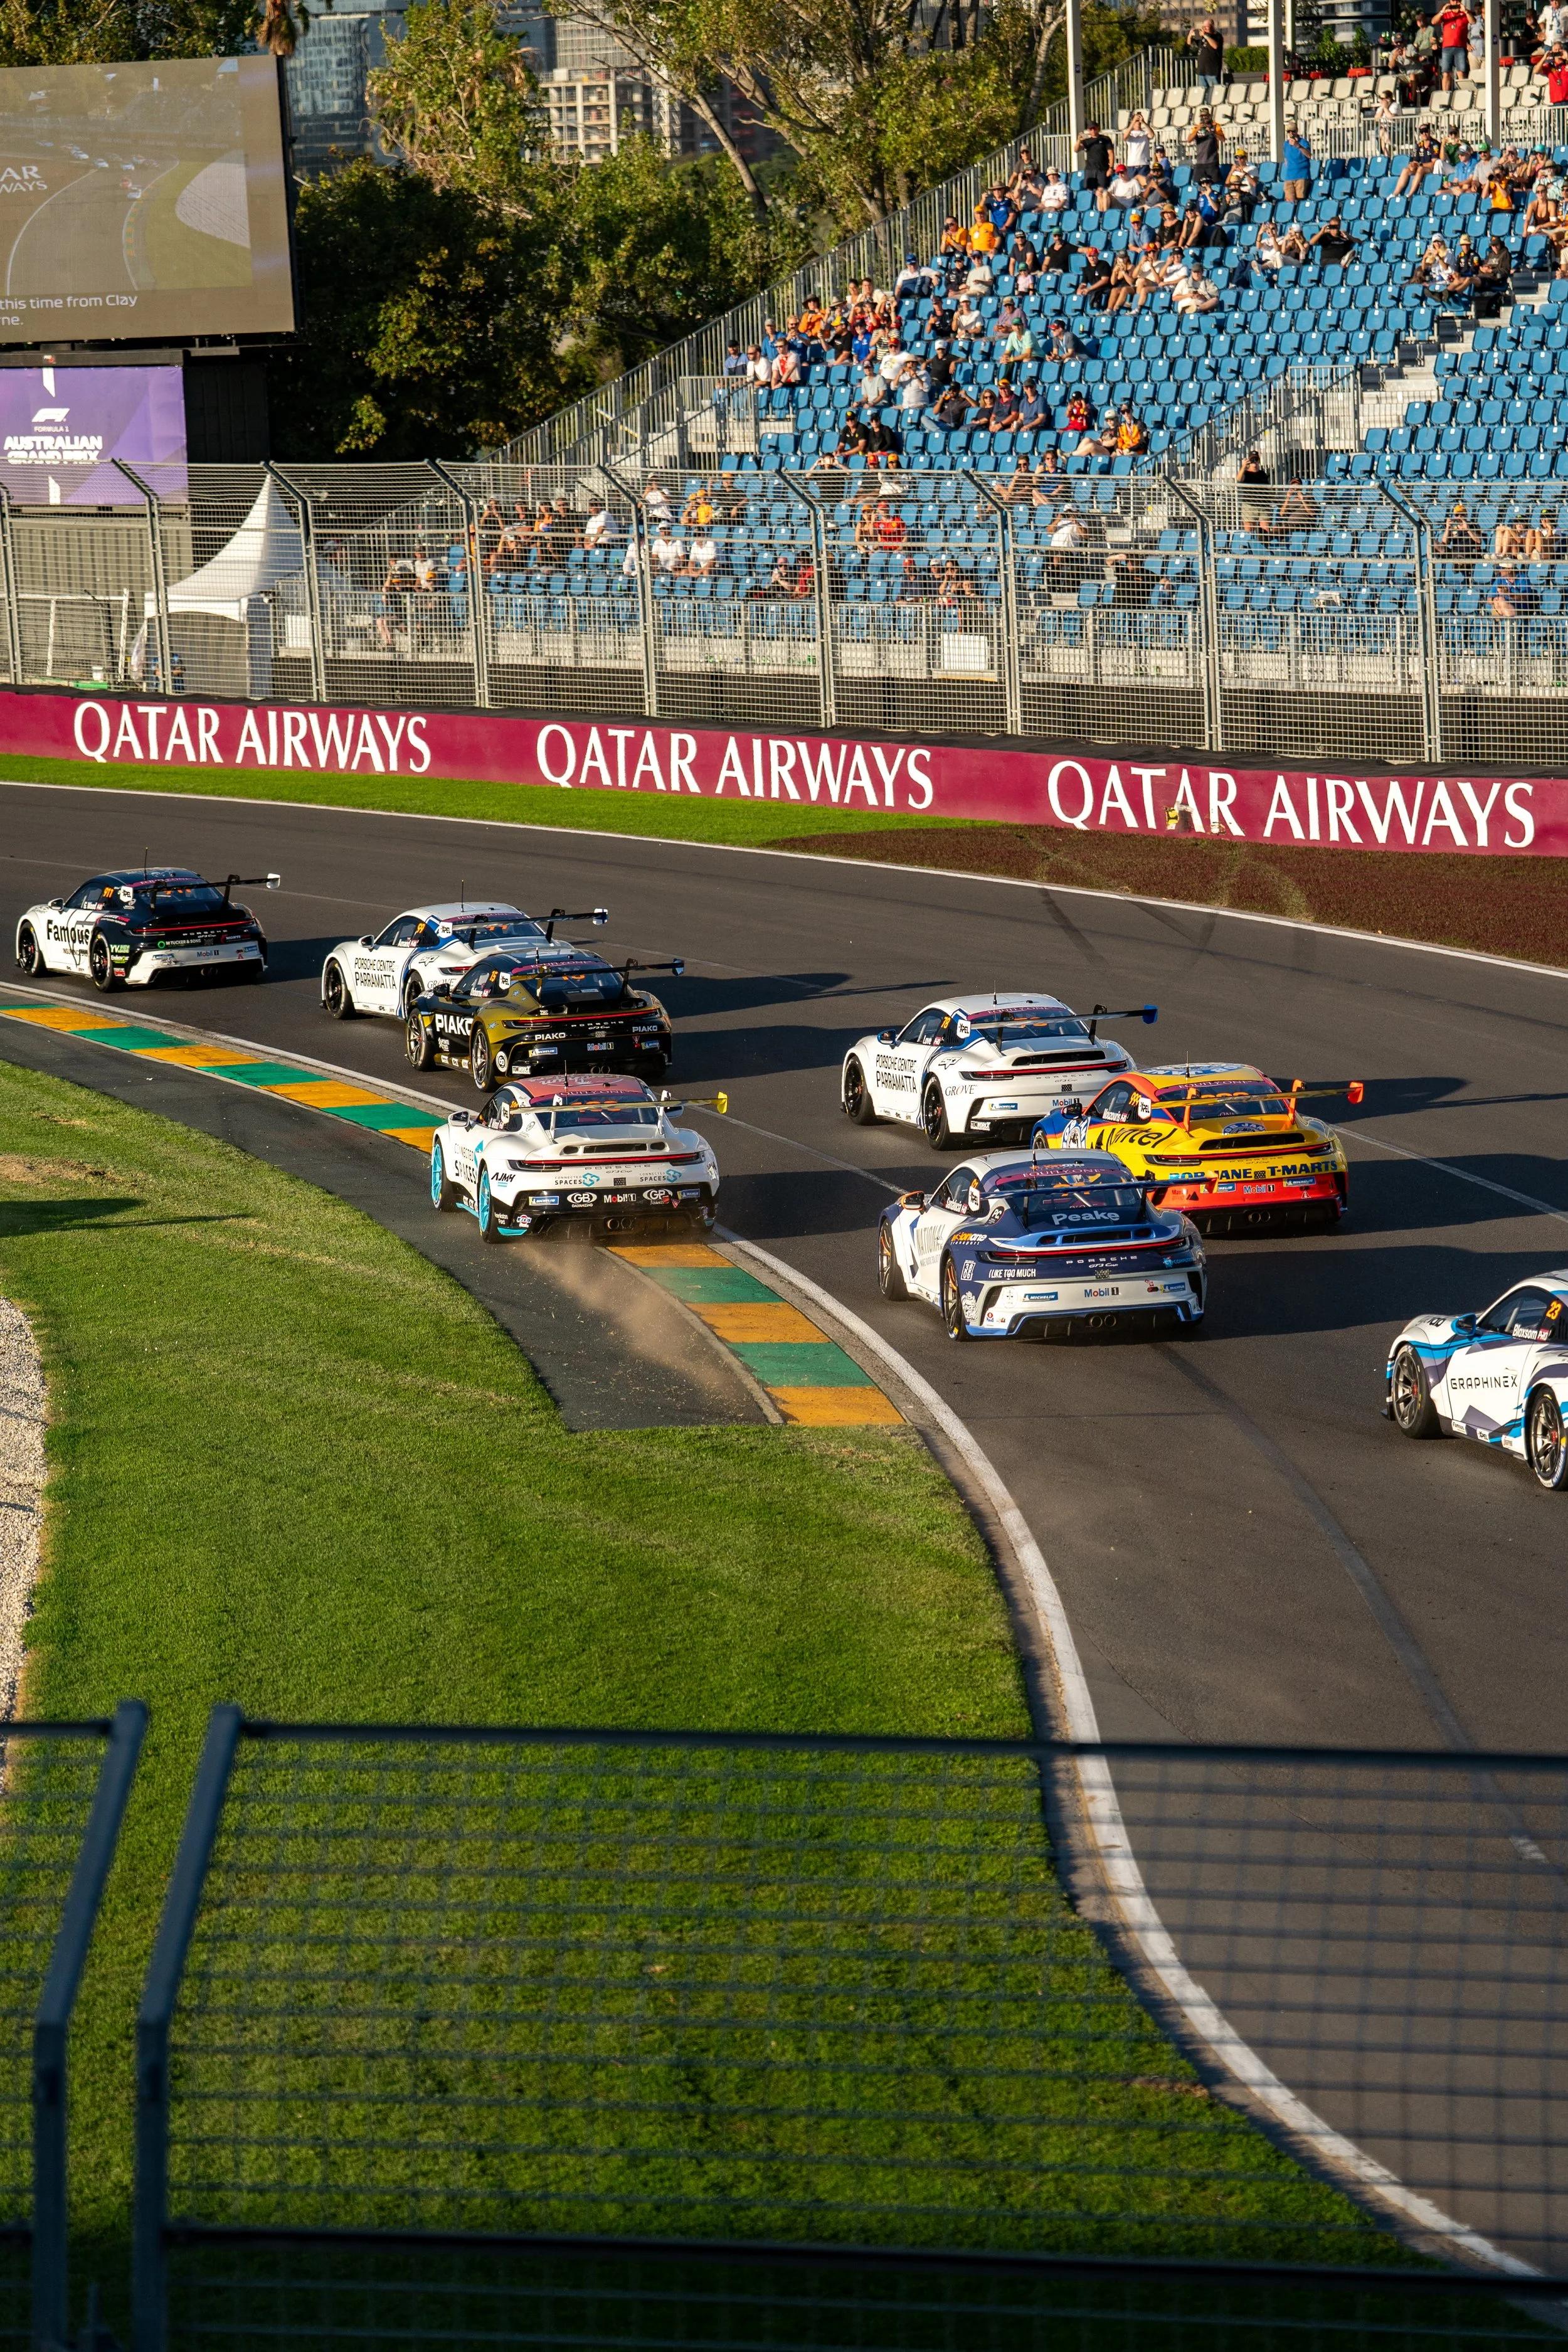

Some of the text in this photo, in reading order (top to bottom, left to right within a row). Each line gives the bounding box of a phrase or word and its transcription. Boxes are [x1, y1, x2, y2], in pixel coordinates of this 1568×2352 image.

[0, 294, 138, 310] this time from Clay
[0, 315, 24, 326] ne.
[4, 435, 103, 450] AUSTRALIAN
[8, 450, 100, 465] GRAND PRIX
[74, 702, 431, 773] QATAR AIRWAYS
[537, 724, 933, 810] QATAR AIRWAYS
[1047, 761, 1535, 848] QATAR AIRWAYS
[103, 887, 114, 898] 911
[46, 919, 90, 946] Famous
[416, 923, 426, 933] 99
[354, 958, 395, 972] PORSCHE CENTRE
[355, 972, 397, 990] PARRAMATTA
[489, 970, 499, 982] 15
[941, 1016, 951, 1029] 78
[958, 1023, 969, 1034] XPEL
[632, 1025, 658, 1033] PIAKO
[534, 1032, 566, 1041] PIAKO
[923, 1035, 931, 1045] Love
[587, 1042, 607, 1051] Mobil
[876, 1054, 917, 1073] PORSCHE CENTRE
[876, 1071, 918, 1093] PARRAMATTA
[945, 1084, 975, 1096] GROVE
[1052, 1098, 1073, 1106] Mobil
[1140, 1102, 1150, 1113] XPEL
[1241, 1122, 1265, 1131] JAN
[455, 1160, 477, 1185] SPACES
[1214, 1168, 1252, 1180] JANE
[1266, 1160, 1338, 1177] T-MARTS
[1243, 1186, 1266, 1194] Mobil
[573, 1194, 591, 1203] GB
[603, 1194, 628, 1203] Mobil
[1052, 1210, 1120, 1226] Peake
[1066, 1256, 1138, 1264] PORSCHE
[965, 1263, 973, 1271] 38
[988, 1268, 1036, 1278] I LIKE TOO MUCH
[1084, 1287, 1119, 1298] Mobil 1
[1545, 1300, 1562, 1320] 23
[1512, 1324, 1548, 1341] Bloxsom PRO
[1450, 1375, 1518, 1389] GRAPHINEX
